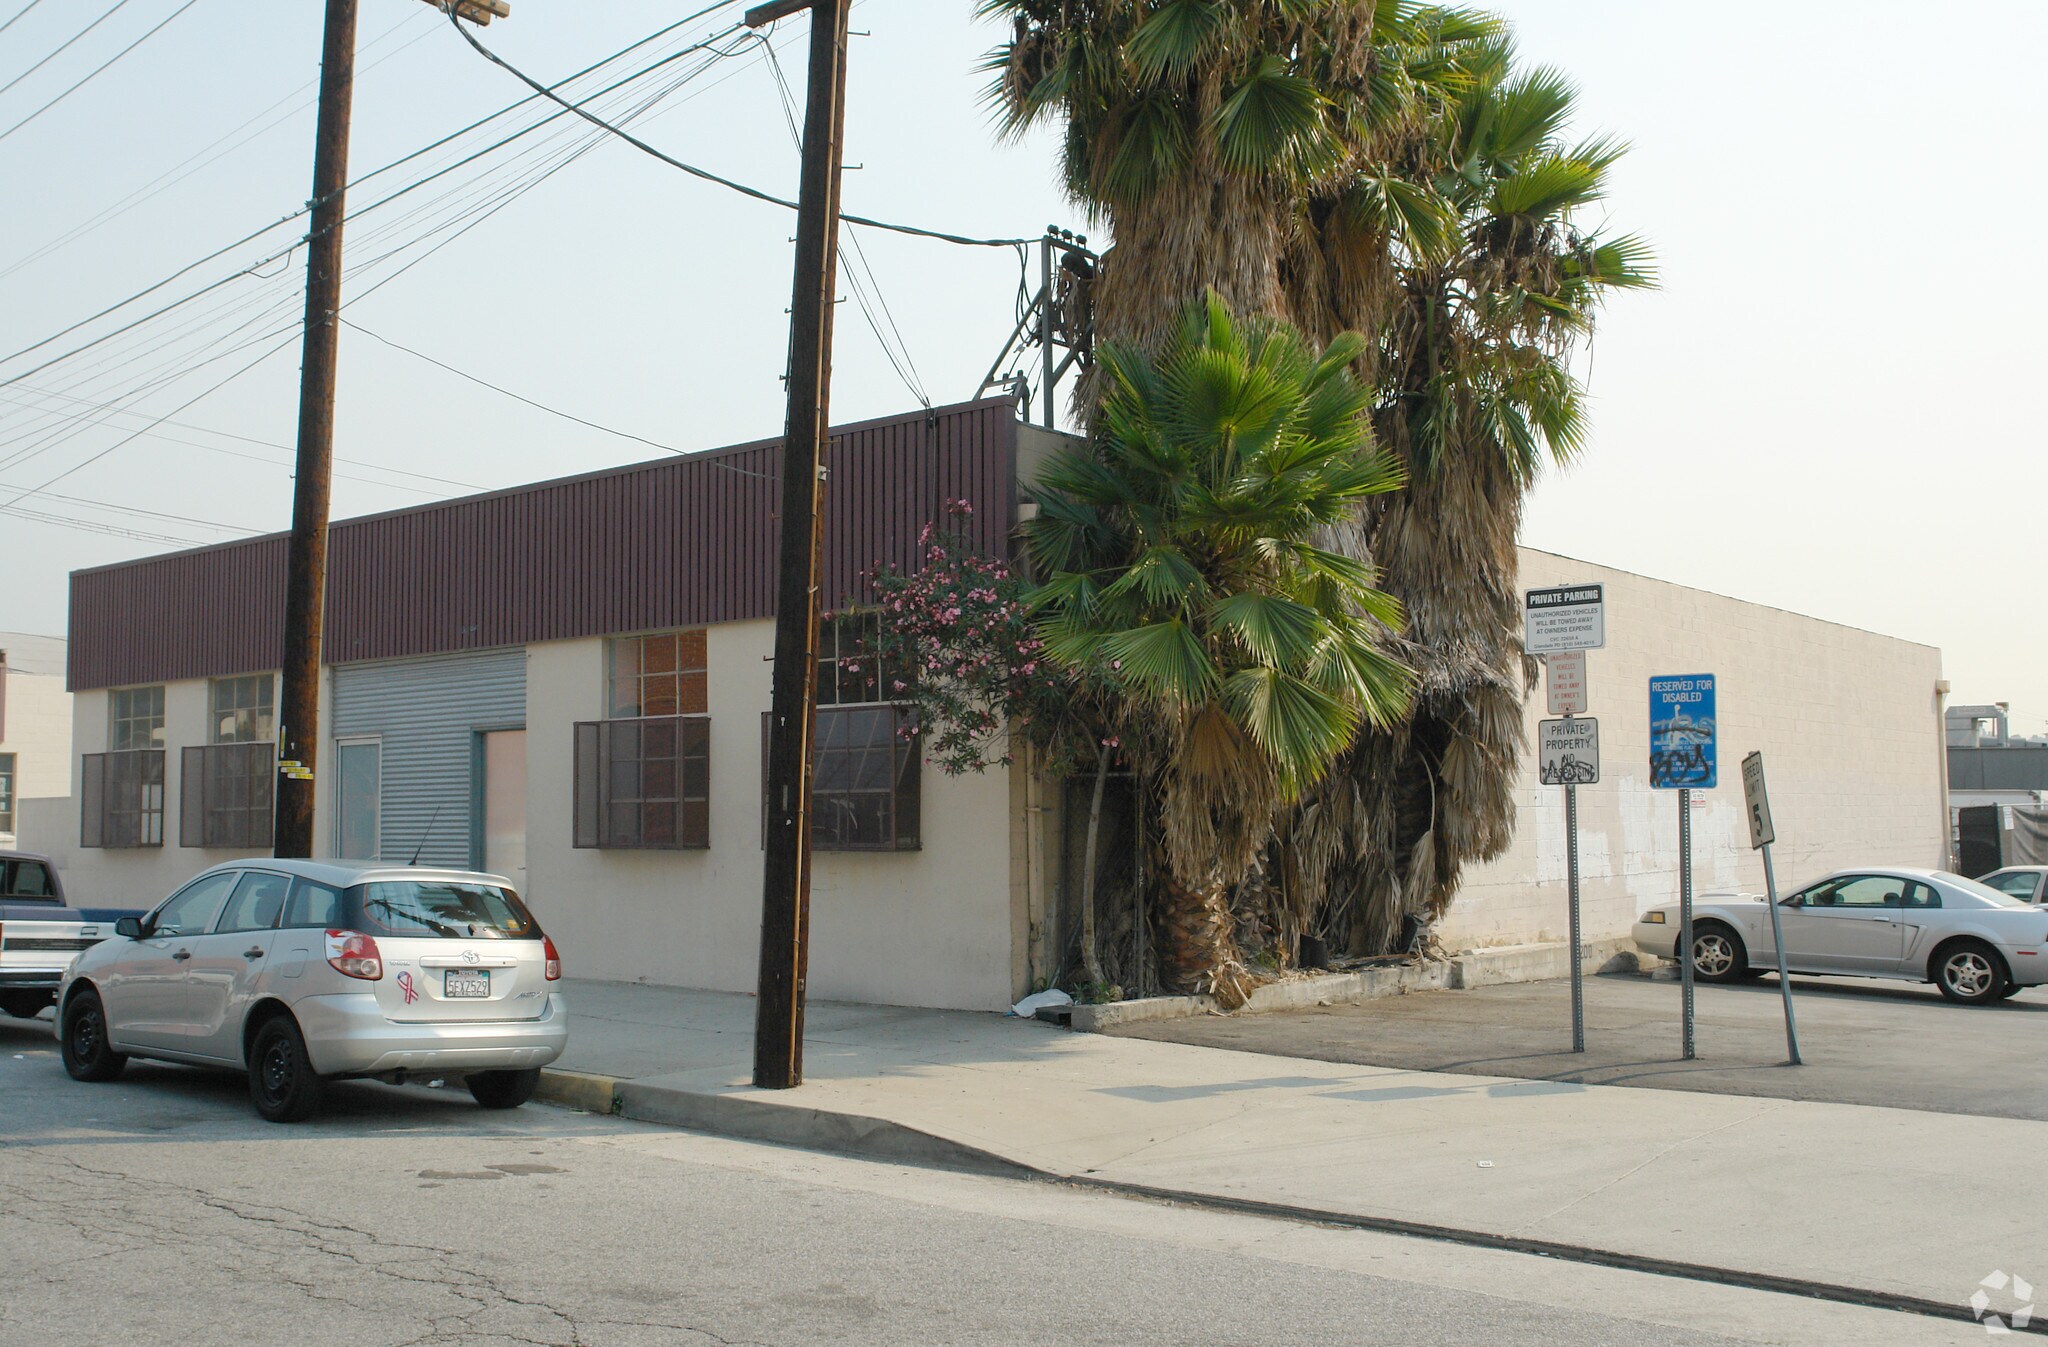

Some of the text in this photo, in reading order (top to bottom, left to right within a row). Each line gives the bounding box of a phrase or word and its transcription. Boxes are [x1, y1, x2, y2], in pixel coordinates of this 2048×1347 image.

[1529, 589, 1599, 605] PRIVATE PARKING
[1530, 607, 1598, 619] UNAUTHORIZED VEHICLES
[1544, 626, 1568, 634] OWNERS
[1568, 625, 1593, 633] EXPENSE
[1652, 679, 1713, 693] RESERVED FOR
[1662, 692, 1702, 703] DISABLED
[1551, 724, 1585, 735] PRIVATE
[1546, 738, 1591, 750] PROPERTY
[1562, 753, 1575, 764] NO
[1744, 761, 1760, 781] SPEED
[1752, 803, 1763, 837] 5
